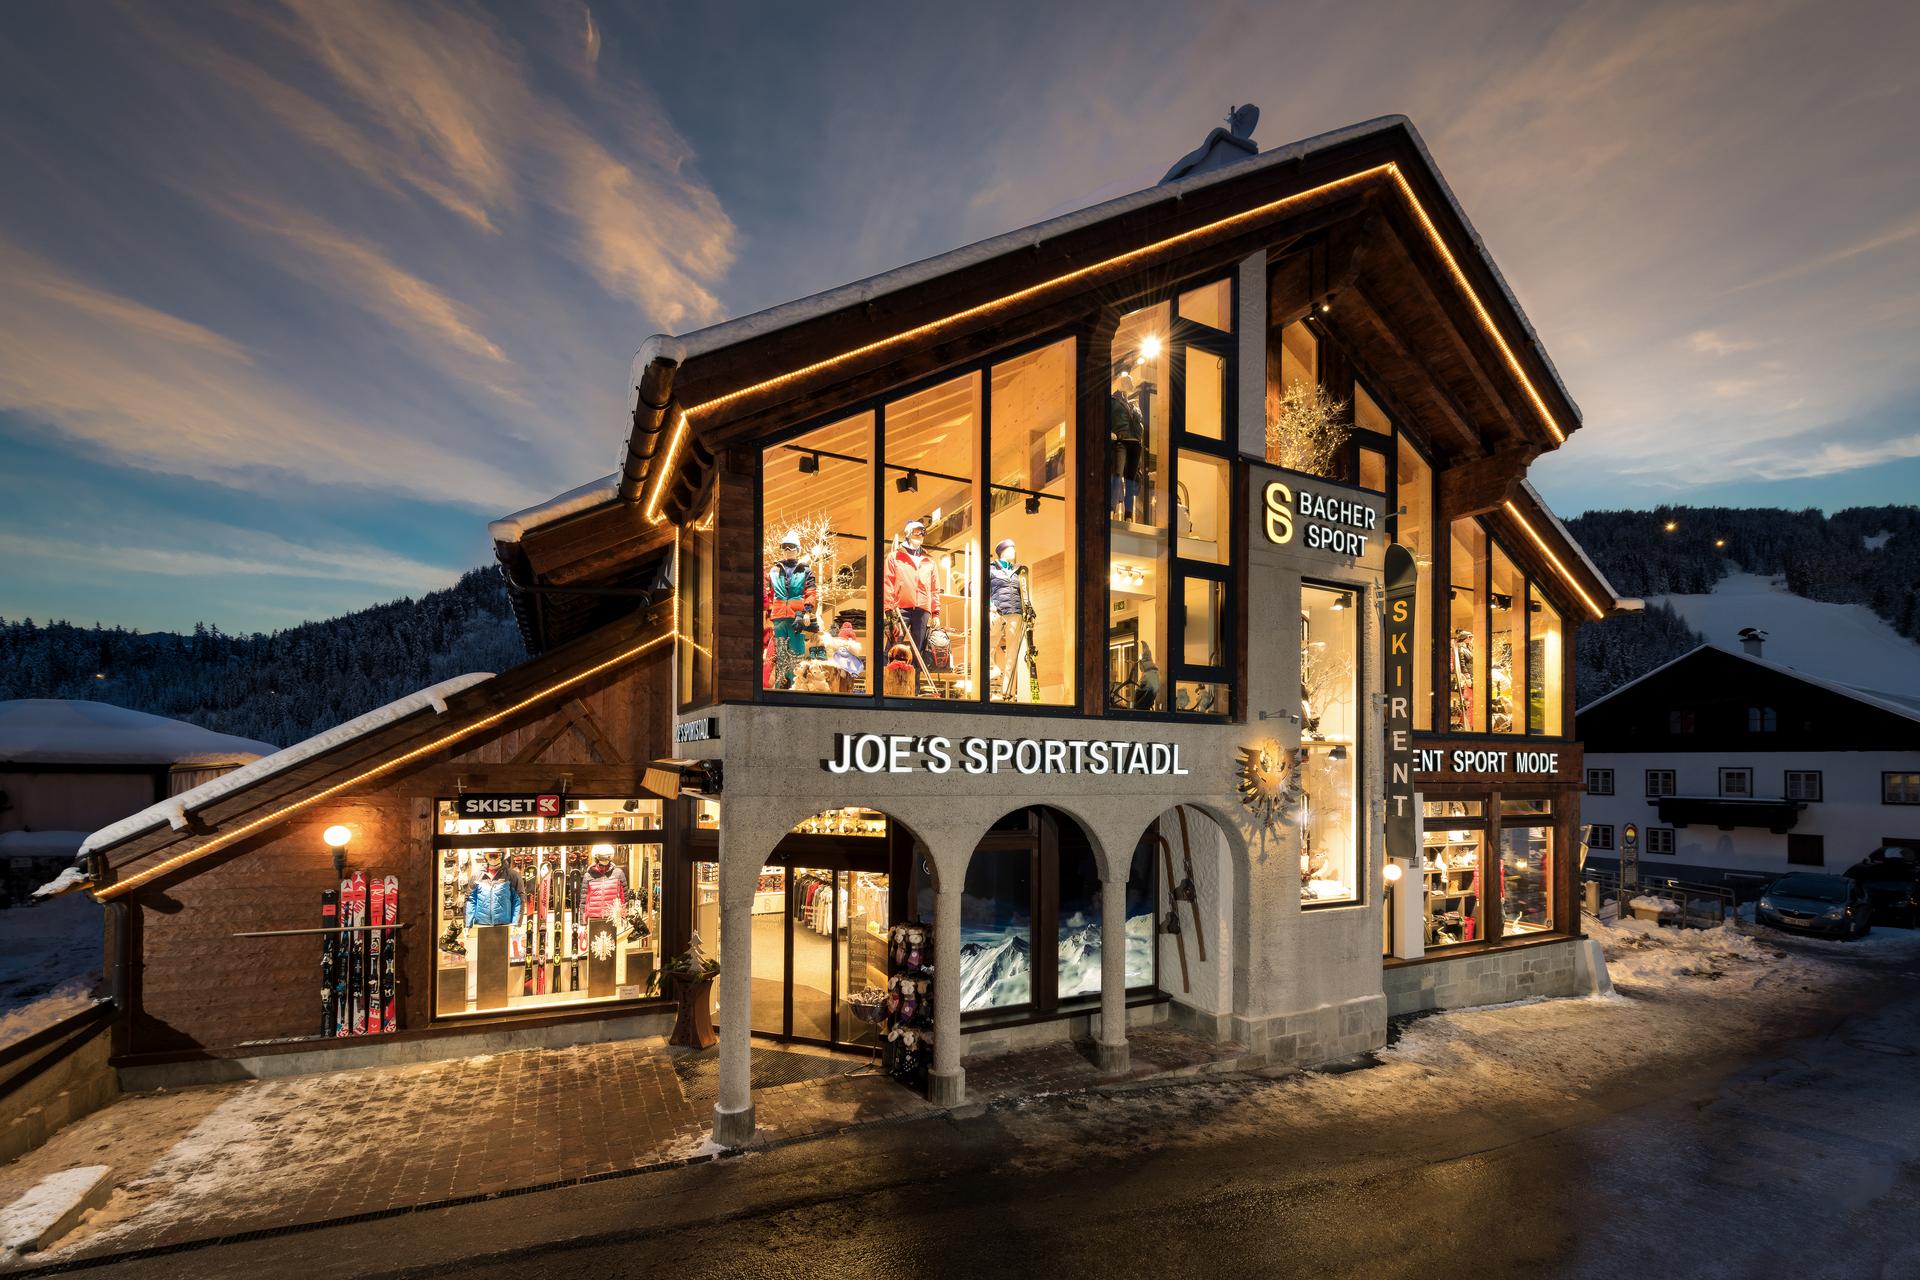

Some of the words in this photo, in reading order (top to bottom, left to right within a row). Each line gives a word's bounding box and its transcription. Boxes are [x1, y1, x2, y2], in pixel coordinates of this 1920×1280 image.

[1300, 491, 1376, 530] BACHER
[1308, 524, 1369, 557] SPORT
[828, 734, 951, 775] JOE'S
[965, 736, 1189, 775] SPORTSTADL
[1413, 749, 1445, 772] ENT
[1453, 750, 1508, 773] SPORT
[1516, 752, 1559, 774] MODE
[465, 799, 536, 813] SKISET
